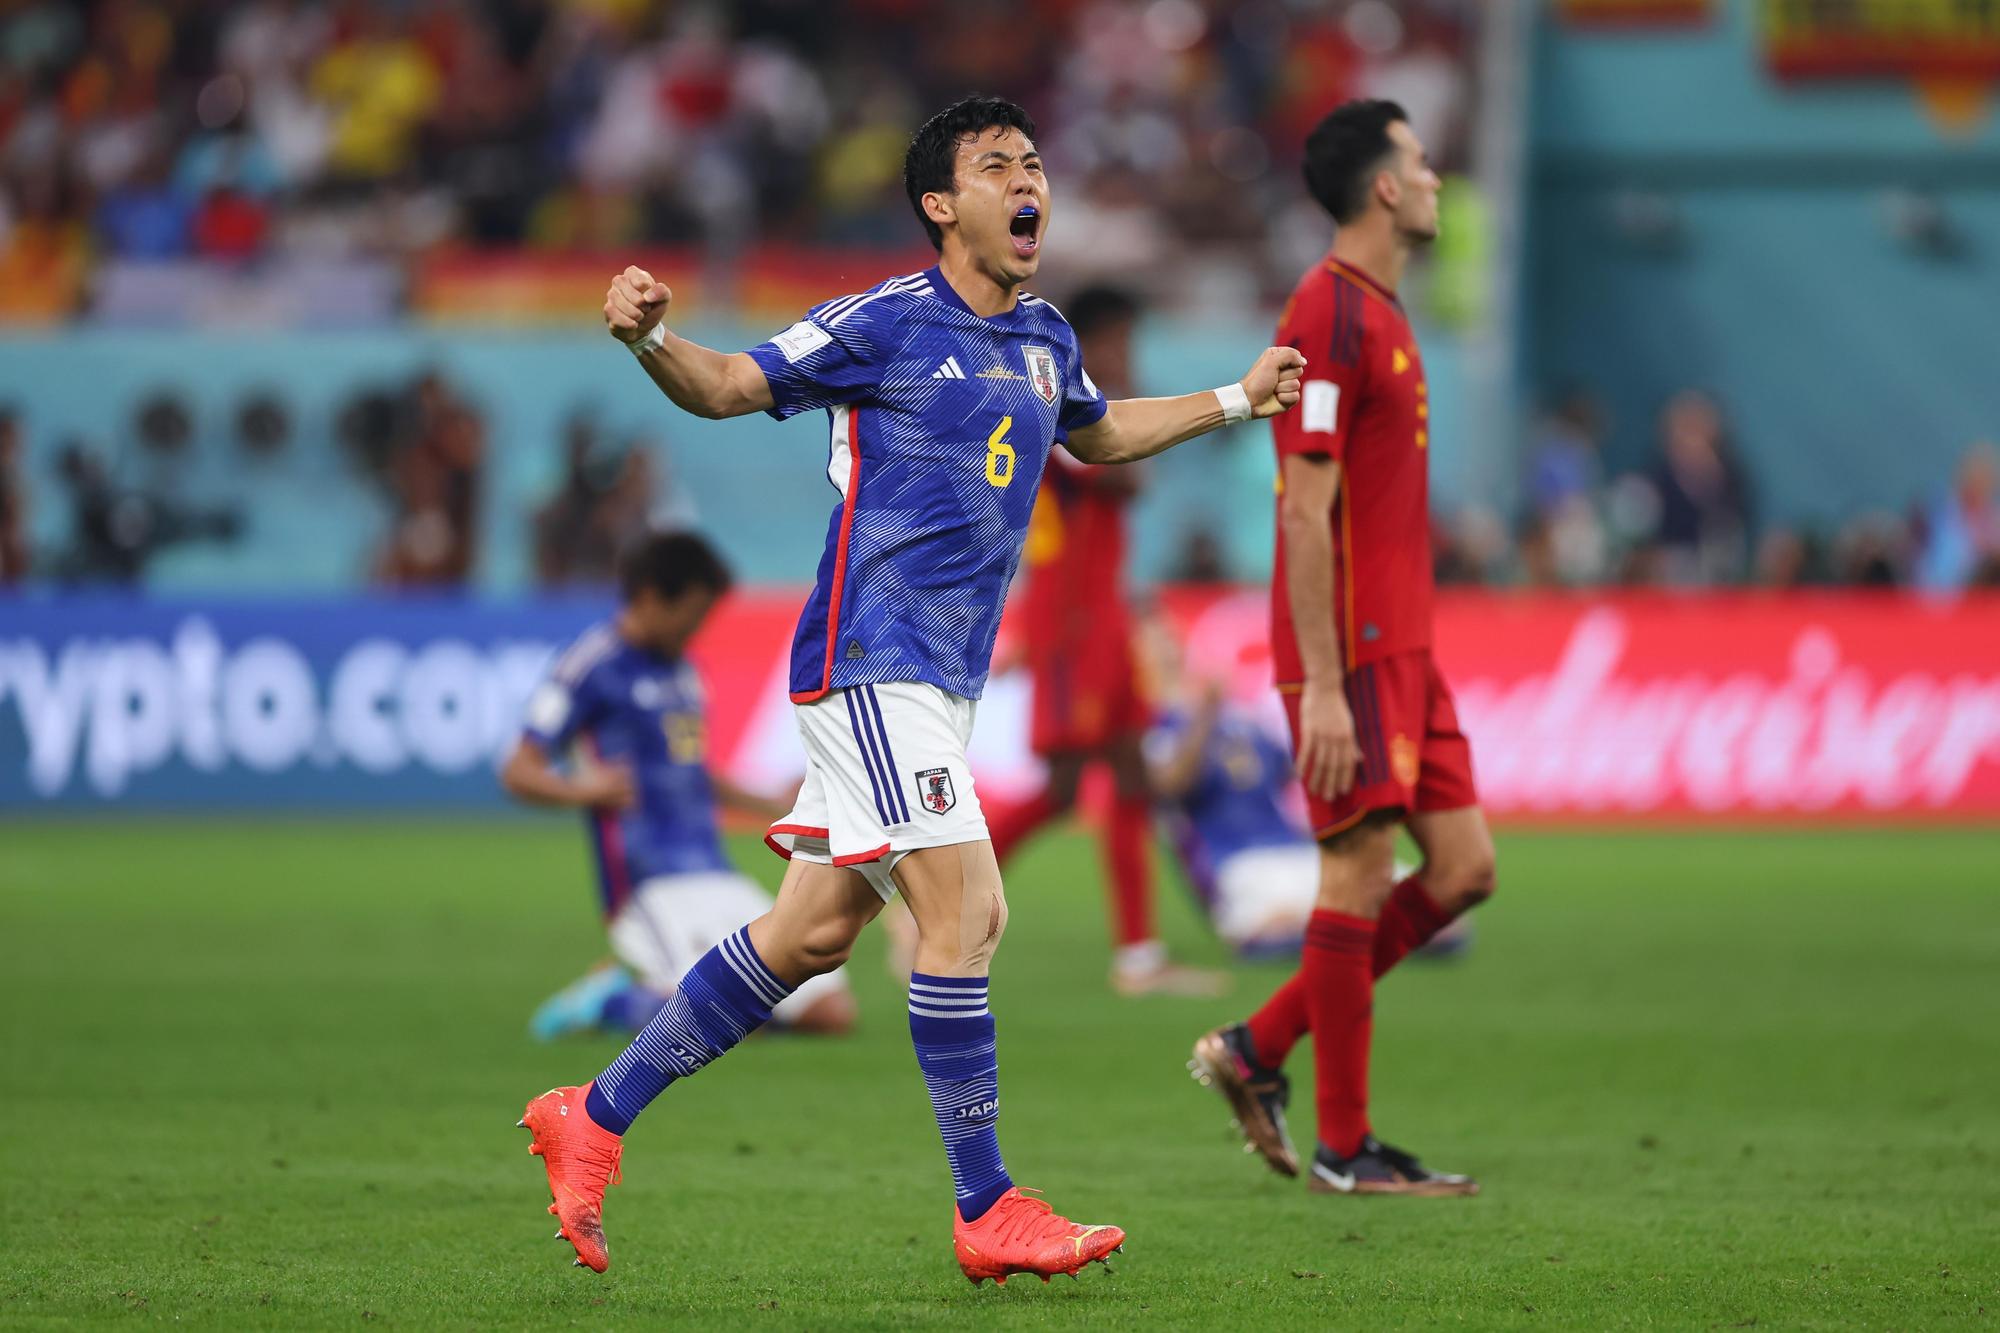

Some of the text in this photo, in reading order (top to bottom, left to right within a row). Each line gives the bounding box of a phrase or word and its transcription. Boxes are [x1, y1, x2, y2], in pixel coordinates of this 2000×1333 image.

[985, 415, 1017, 488] 6
[670, 1046, 704, 1071] JAP
[955, 1097, 999, 1119] JAPA
